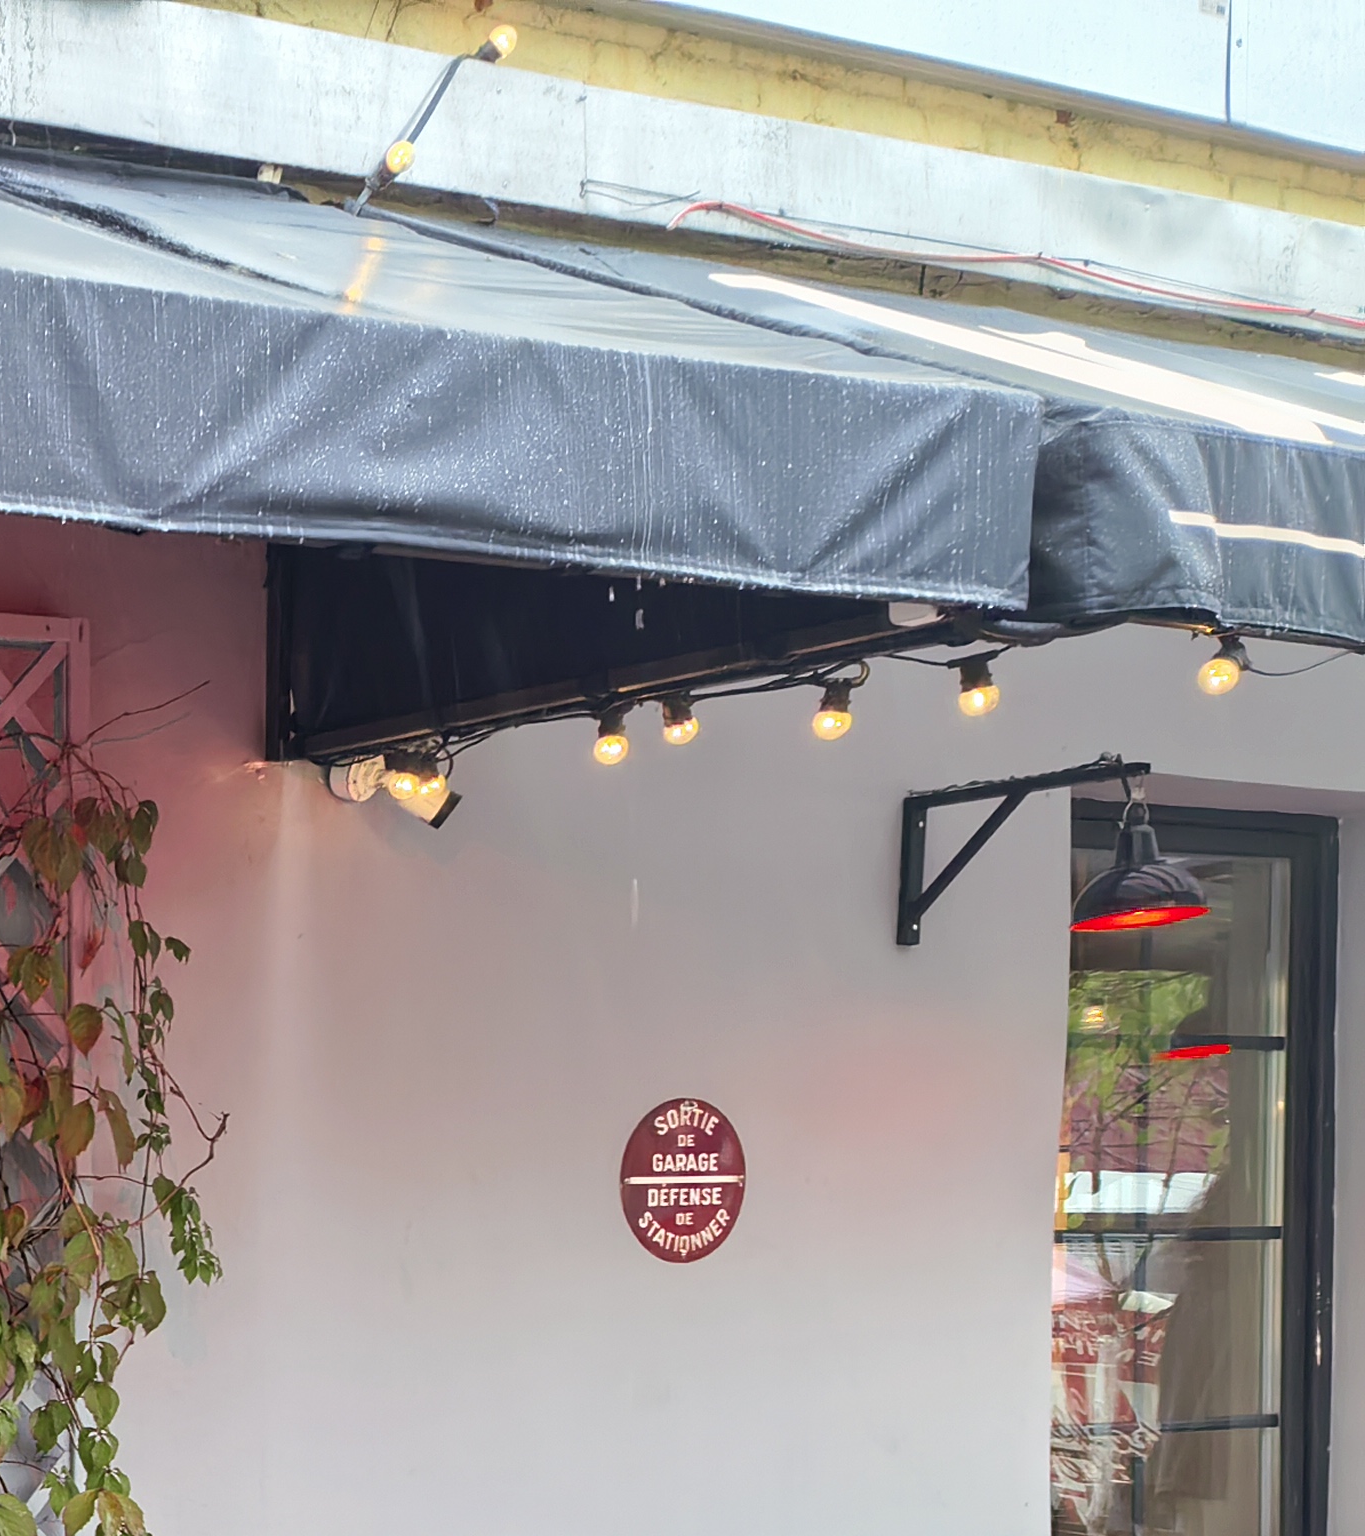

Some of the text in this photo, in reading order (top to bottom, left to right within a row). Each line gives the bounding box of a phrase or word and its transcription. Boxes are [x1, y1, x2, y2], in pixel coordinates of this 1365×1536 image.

[654, 1108, 719, 1136] SORTIE
[677, 1134, 695, 1147] DE
[652, 1153, 719, 1172] GARAGE
[676, 1212, 694, 1226] DE
[638, 1208, 731, 1252] STATIONNER
